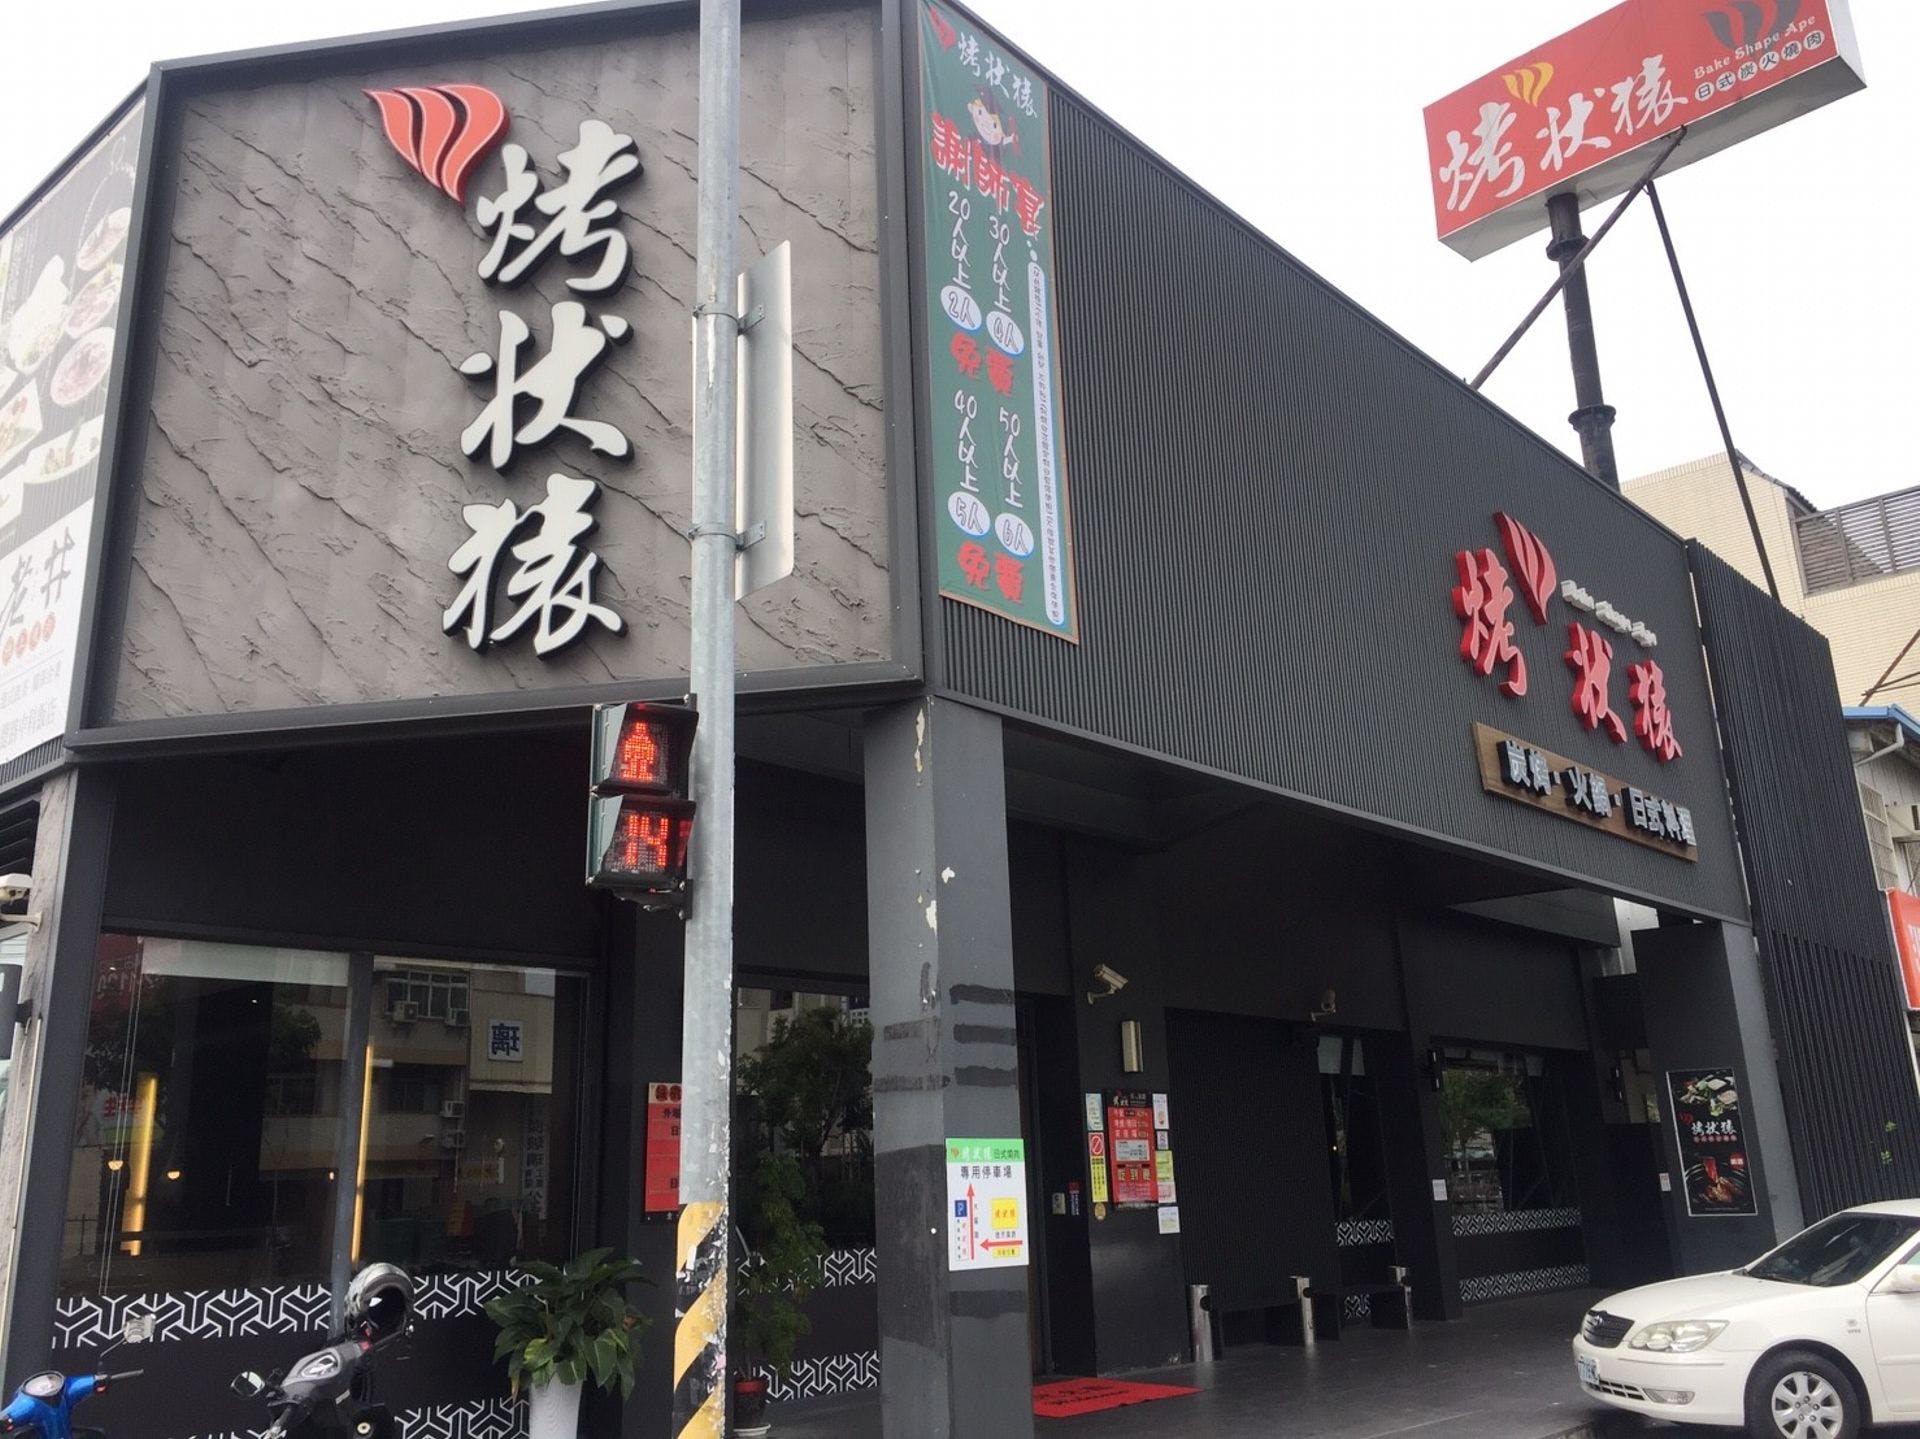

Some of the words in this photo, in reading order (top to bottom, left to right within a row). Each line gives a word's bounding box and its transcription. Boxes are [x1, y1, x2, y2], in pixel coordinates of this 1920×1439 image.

[1694, 57, 1730, 79] Bake
[1735, 32, 1780, 60] Shape
[1785, 16, 1816, 37] Ape
[626, 815, 669, 867] 14
[961, 1166, 1012, 1179] 專用停車場
